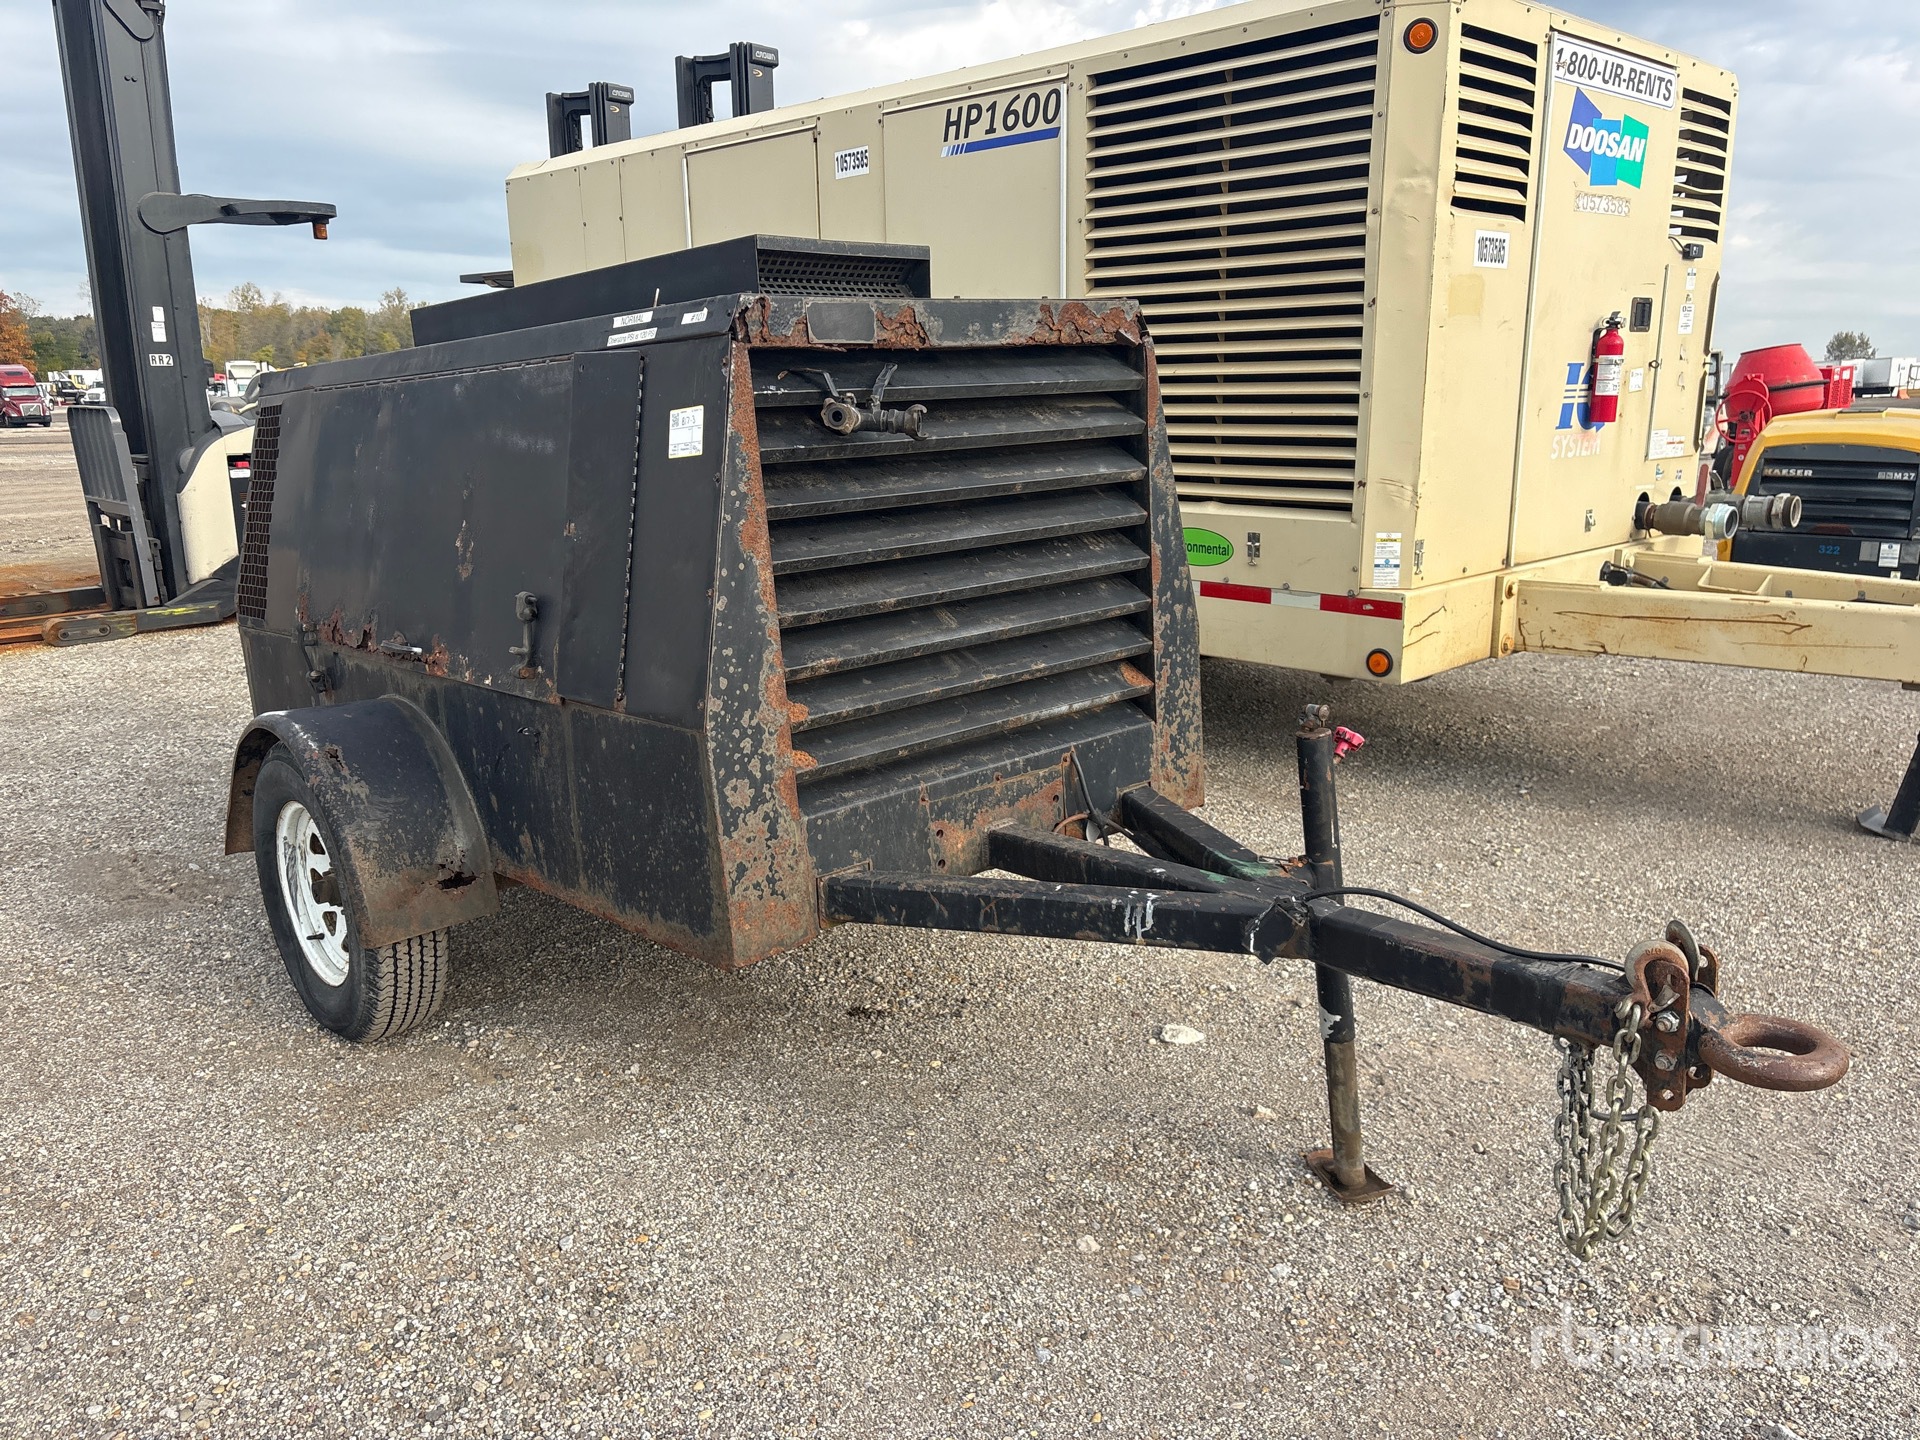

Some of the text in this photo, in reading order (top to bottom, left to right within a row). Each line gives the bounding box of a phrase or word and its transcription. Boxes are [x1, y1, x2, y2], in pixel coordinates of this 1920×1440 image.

[755, 50, 776, 61] CROWN
[611, 89, 632, 98] CROWN
[942, 87, 1061, 143] HP1600
[1566, 123, 1646, 163] DOOSAN
[835, 149, 869, 173] 10573585
[1477, 236, 1506, 264] 10573585
[620, 314, 644, 326] NORMAL
[151, 355, 172, 365] RR2
[1550, 433, 1602, 460] SYSTEM
[1763, 468, 1813, 477] KAESER
[1818, 545, 1841, 555] 322
